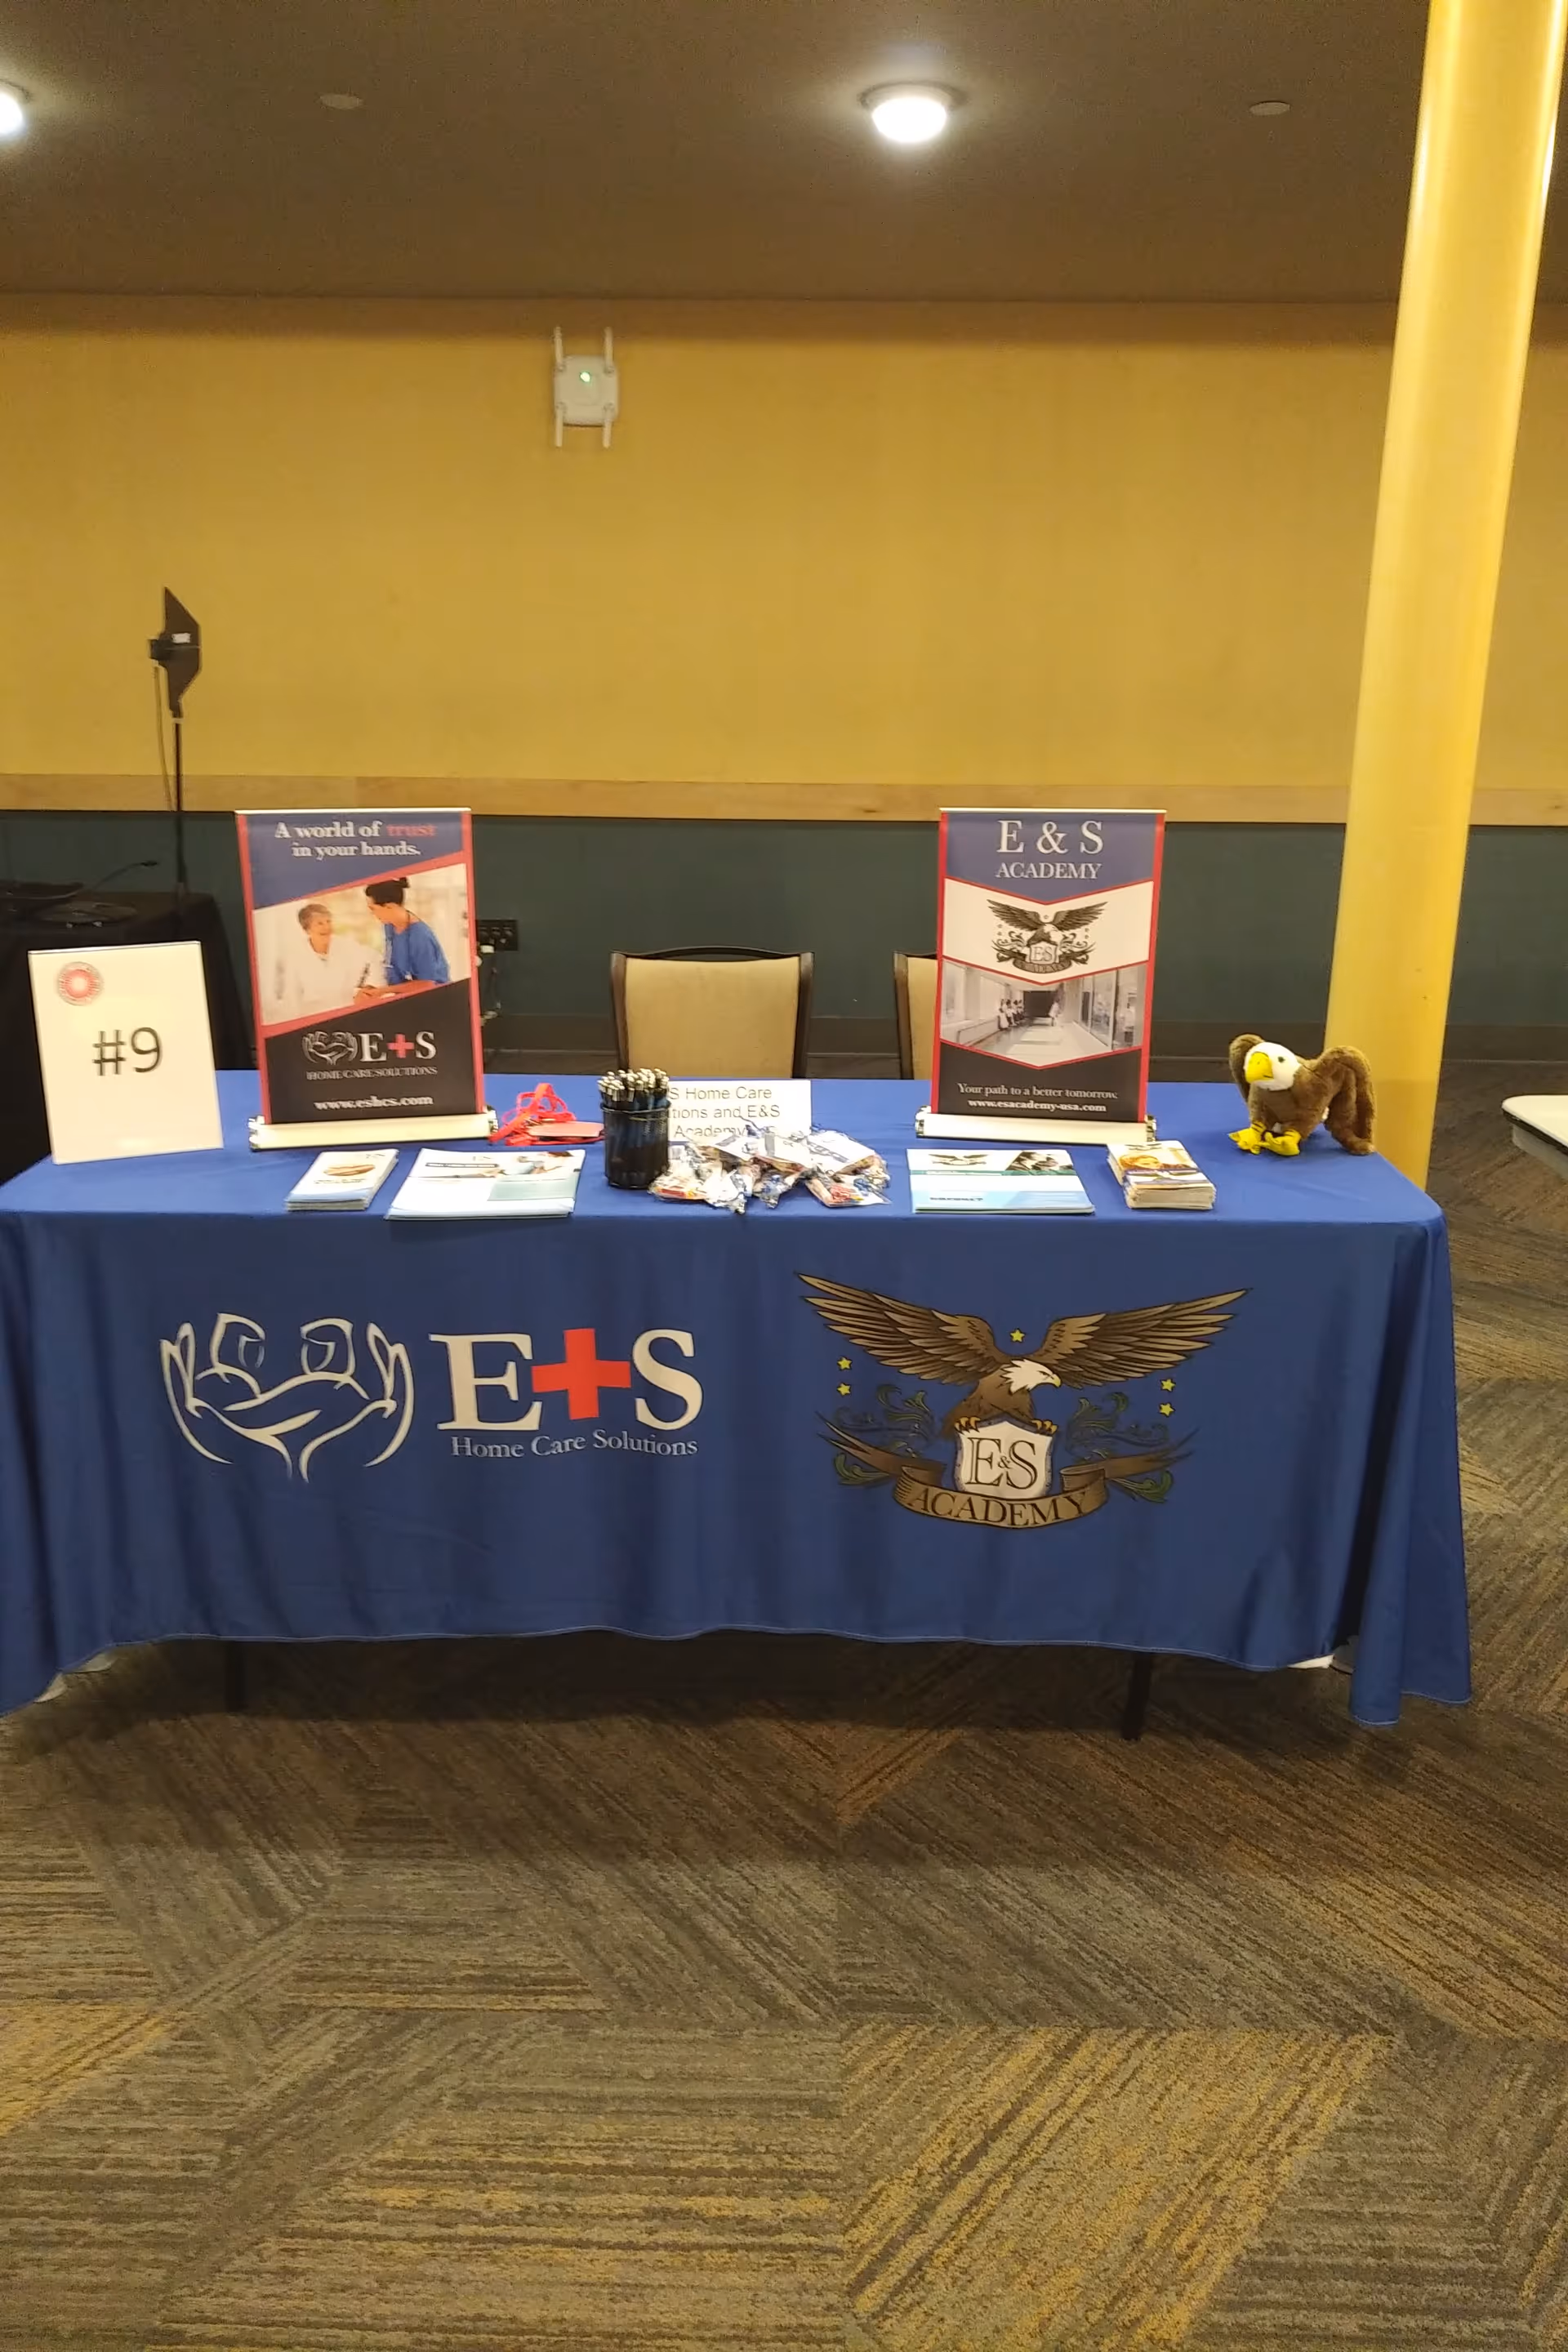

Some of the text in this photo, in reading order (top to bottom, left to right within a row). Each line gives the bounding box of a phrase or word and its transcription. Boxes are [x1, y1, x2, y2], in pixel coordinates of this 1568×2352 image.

[274, 820, 437, 839] A world of trust
[996, 820, 1103, 854] E & S
[292, 840, 421, 861] in your hands.
[996, 862, 1102, 880] ACADEMY
[91, 1027, 163, 1076] #9
[306, 1067, 438, 1080] HOME CARE SOLUTIONS
[686, 1087, 730, 1100] Home
[736, 1086, 772, 1099] Care
[957, 1083, 1118, 1099] Your path to a better tomorrow.
[314, 1095, 434, 1110] www.eshcs.com
[713, 1106, 742, 1119] and
[747, 1104, 780, 1118] E&S
[968, 1099, 1107, 1112] www.esacademy-usa.com
[451, 1429, 699, 1458] Home Care Solutions
[965, 1437, 1037, 1490] E&S
[906, 1486, 1086, 1526] ACADEMY
